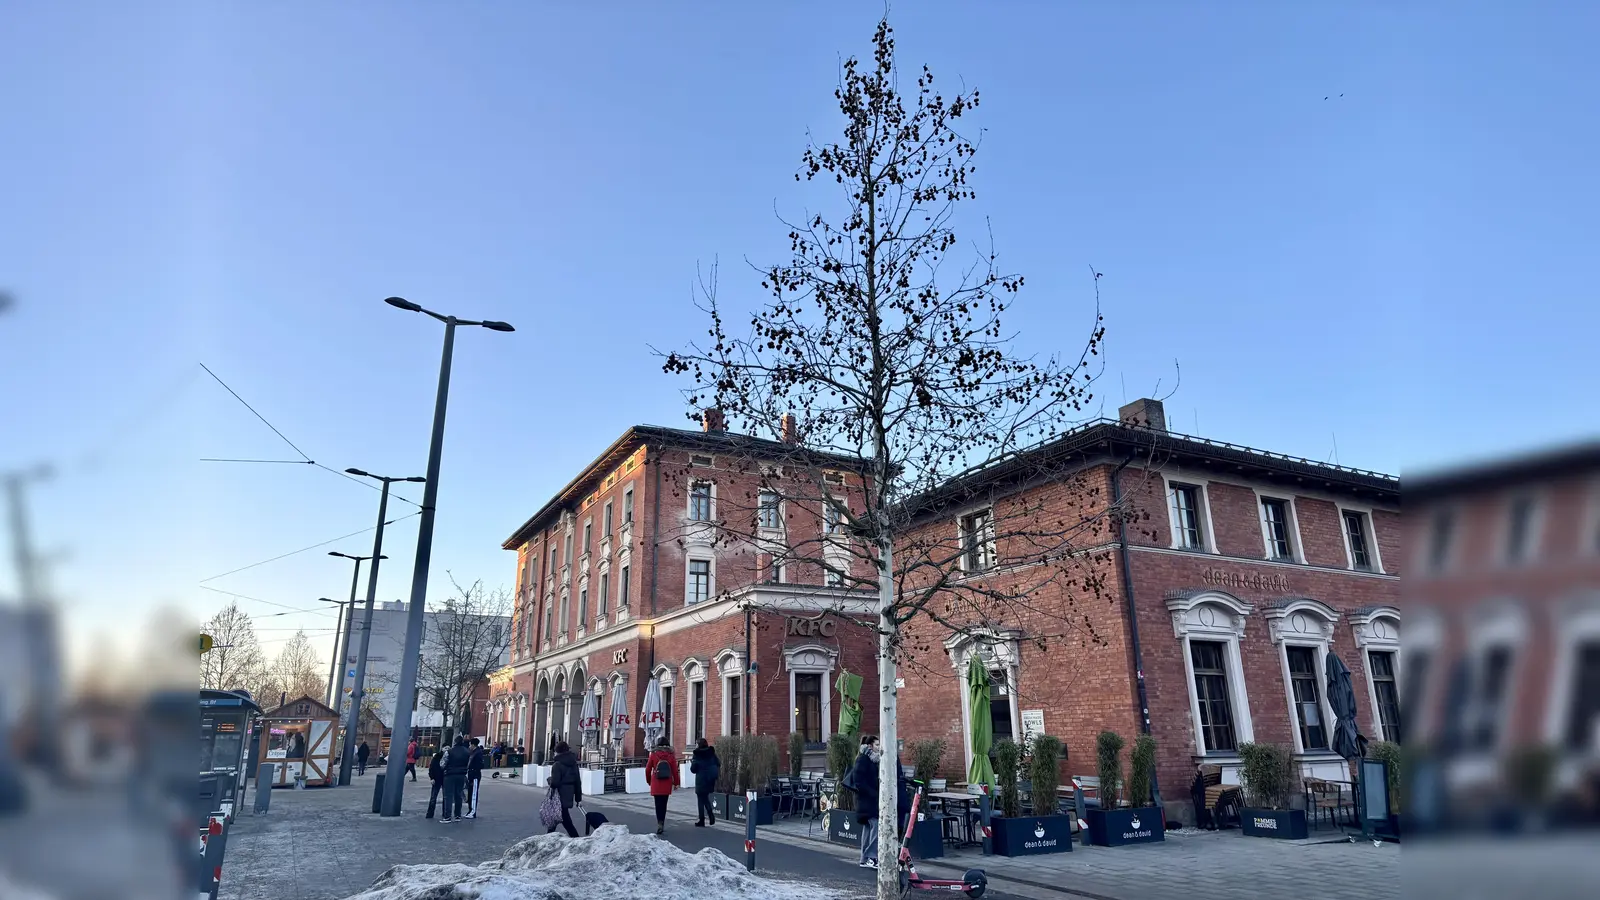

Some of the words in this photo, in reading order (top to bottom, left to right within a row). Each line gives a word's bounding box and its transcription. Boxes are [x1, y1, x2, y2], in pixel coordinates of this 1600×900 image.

[1203, 567, 1239, 588] dean
[1252, 572, 1290, 592] david
[789, 618, 836, 638] KFC
[612, 648, 628, 665] KFC
[1122, 831, 1135, 839] dean
[1024, 841, 1038, 849] dean
